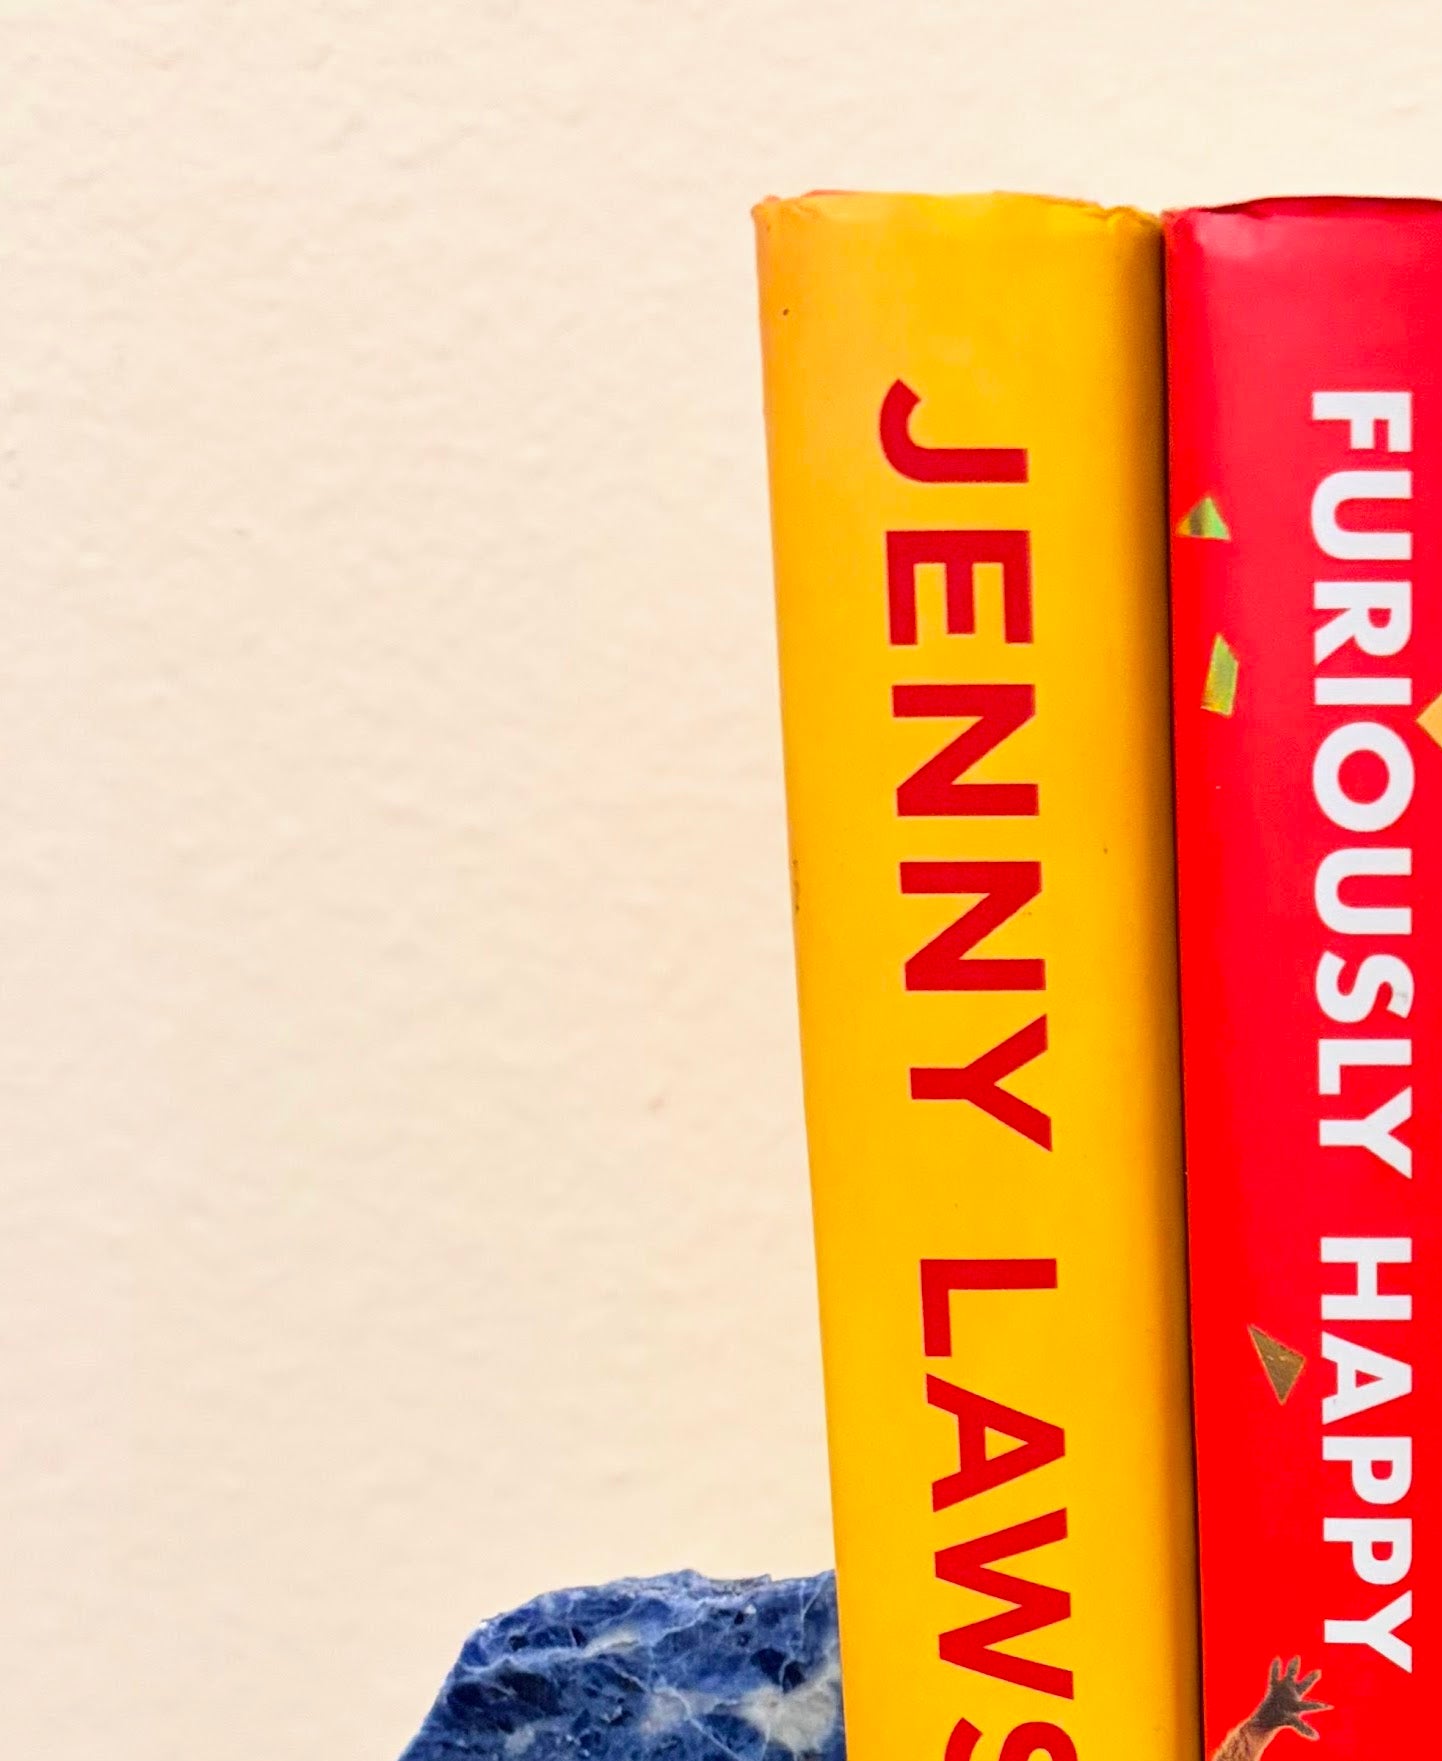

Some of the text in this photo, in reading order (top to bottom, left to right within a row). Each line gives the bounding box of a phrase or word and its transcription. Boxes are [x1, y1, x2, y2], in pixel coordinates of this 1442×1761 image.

[877, 378, 1054, 1153] JENNY
[1309, 389, 1415, 1674] FURIOUSLY HAPPY
